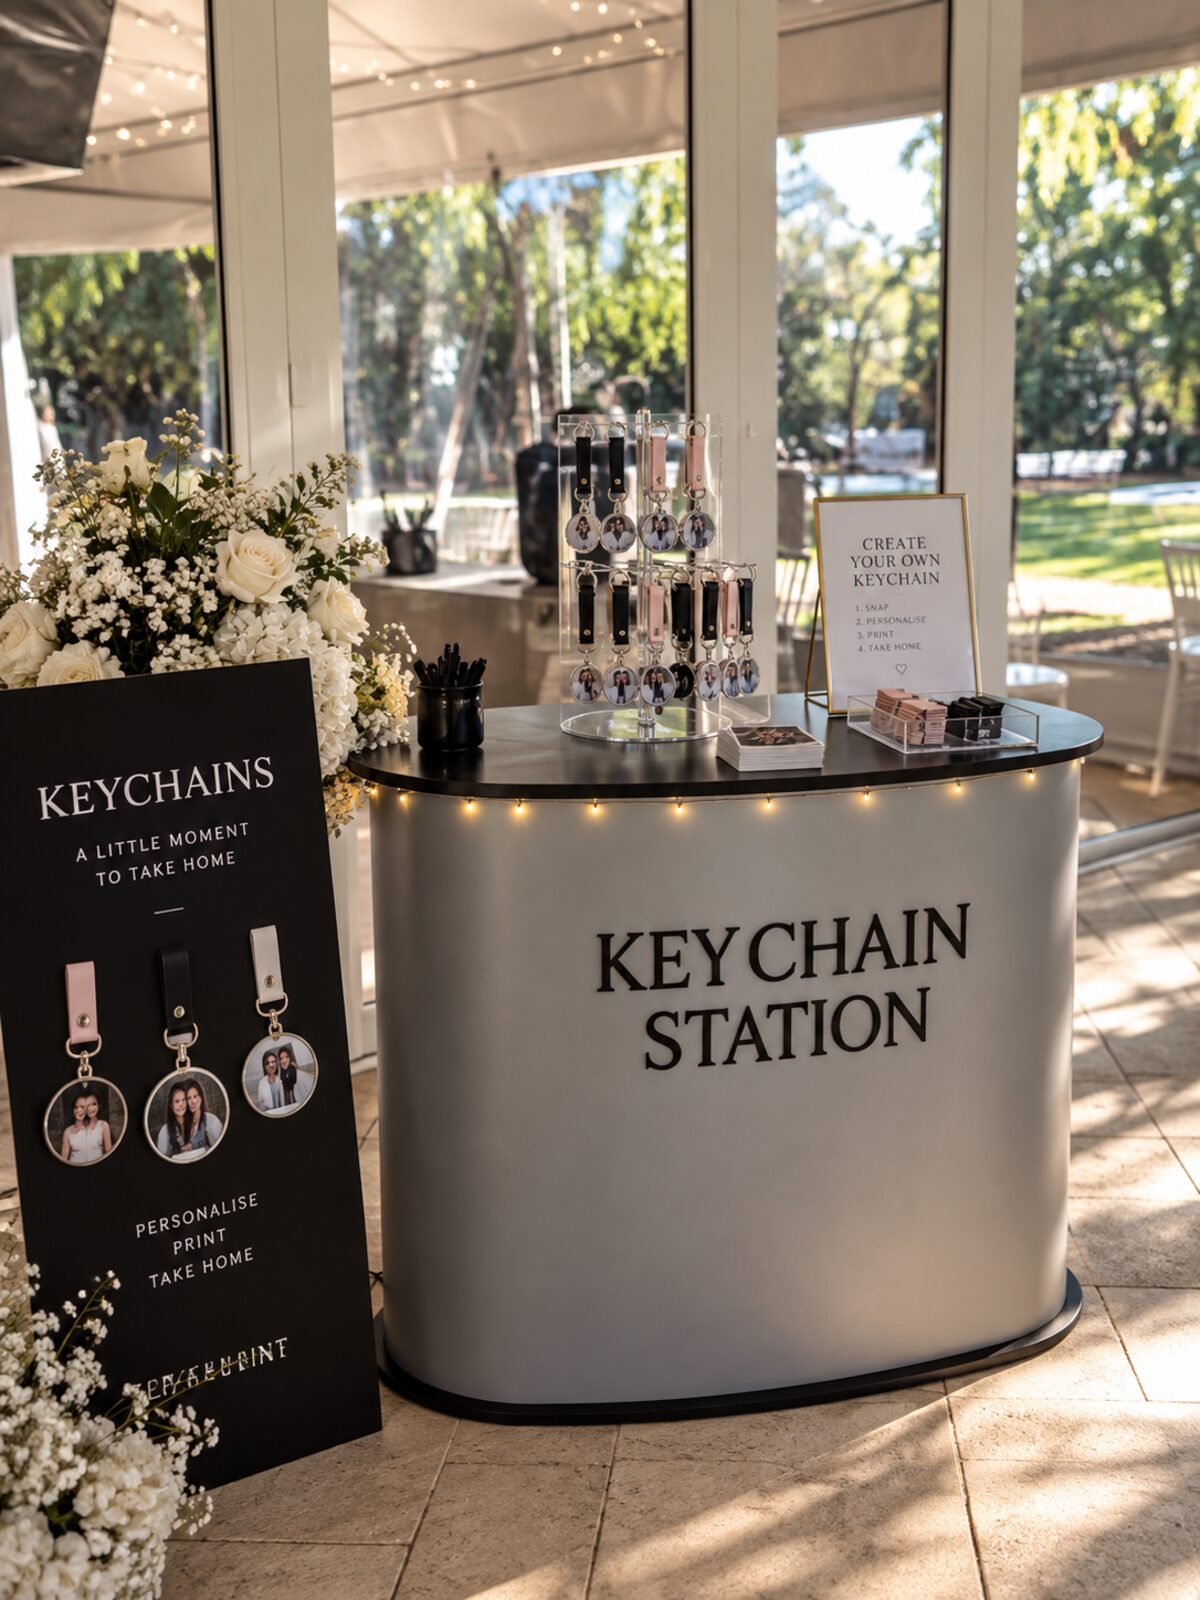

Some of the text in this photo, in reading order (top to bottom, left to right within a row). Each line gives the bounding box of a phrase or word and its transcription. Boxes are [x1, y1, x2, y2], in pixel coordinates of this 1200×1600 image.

[862, 536, 927, 551] CREATE
[850, 553, 941, 569] YOUR OWN
[853, 571, 940, 587] KEYCHAIN
[865, 603, 889, 612] SNAP
[866, 616, 927, 625] PERSONALISE
[867, 630, 894, 639] PRINT
[868, 644, 891, 652] TAKE
[37, 756, 275, 821] KEYCHAINS
[75, 822, 249, 863] A LITTLE MOMENT
[96, 850, 236, 887] TO TAKE HOME
[644, 986, 931, 1072] STATION
[135, 1192, 259, 1239] PERSONALISE
[173, 1227, 227, 1256] PRINT
[148, 1246, 255, 1289] TAKE HOME
